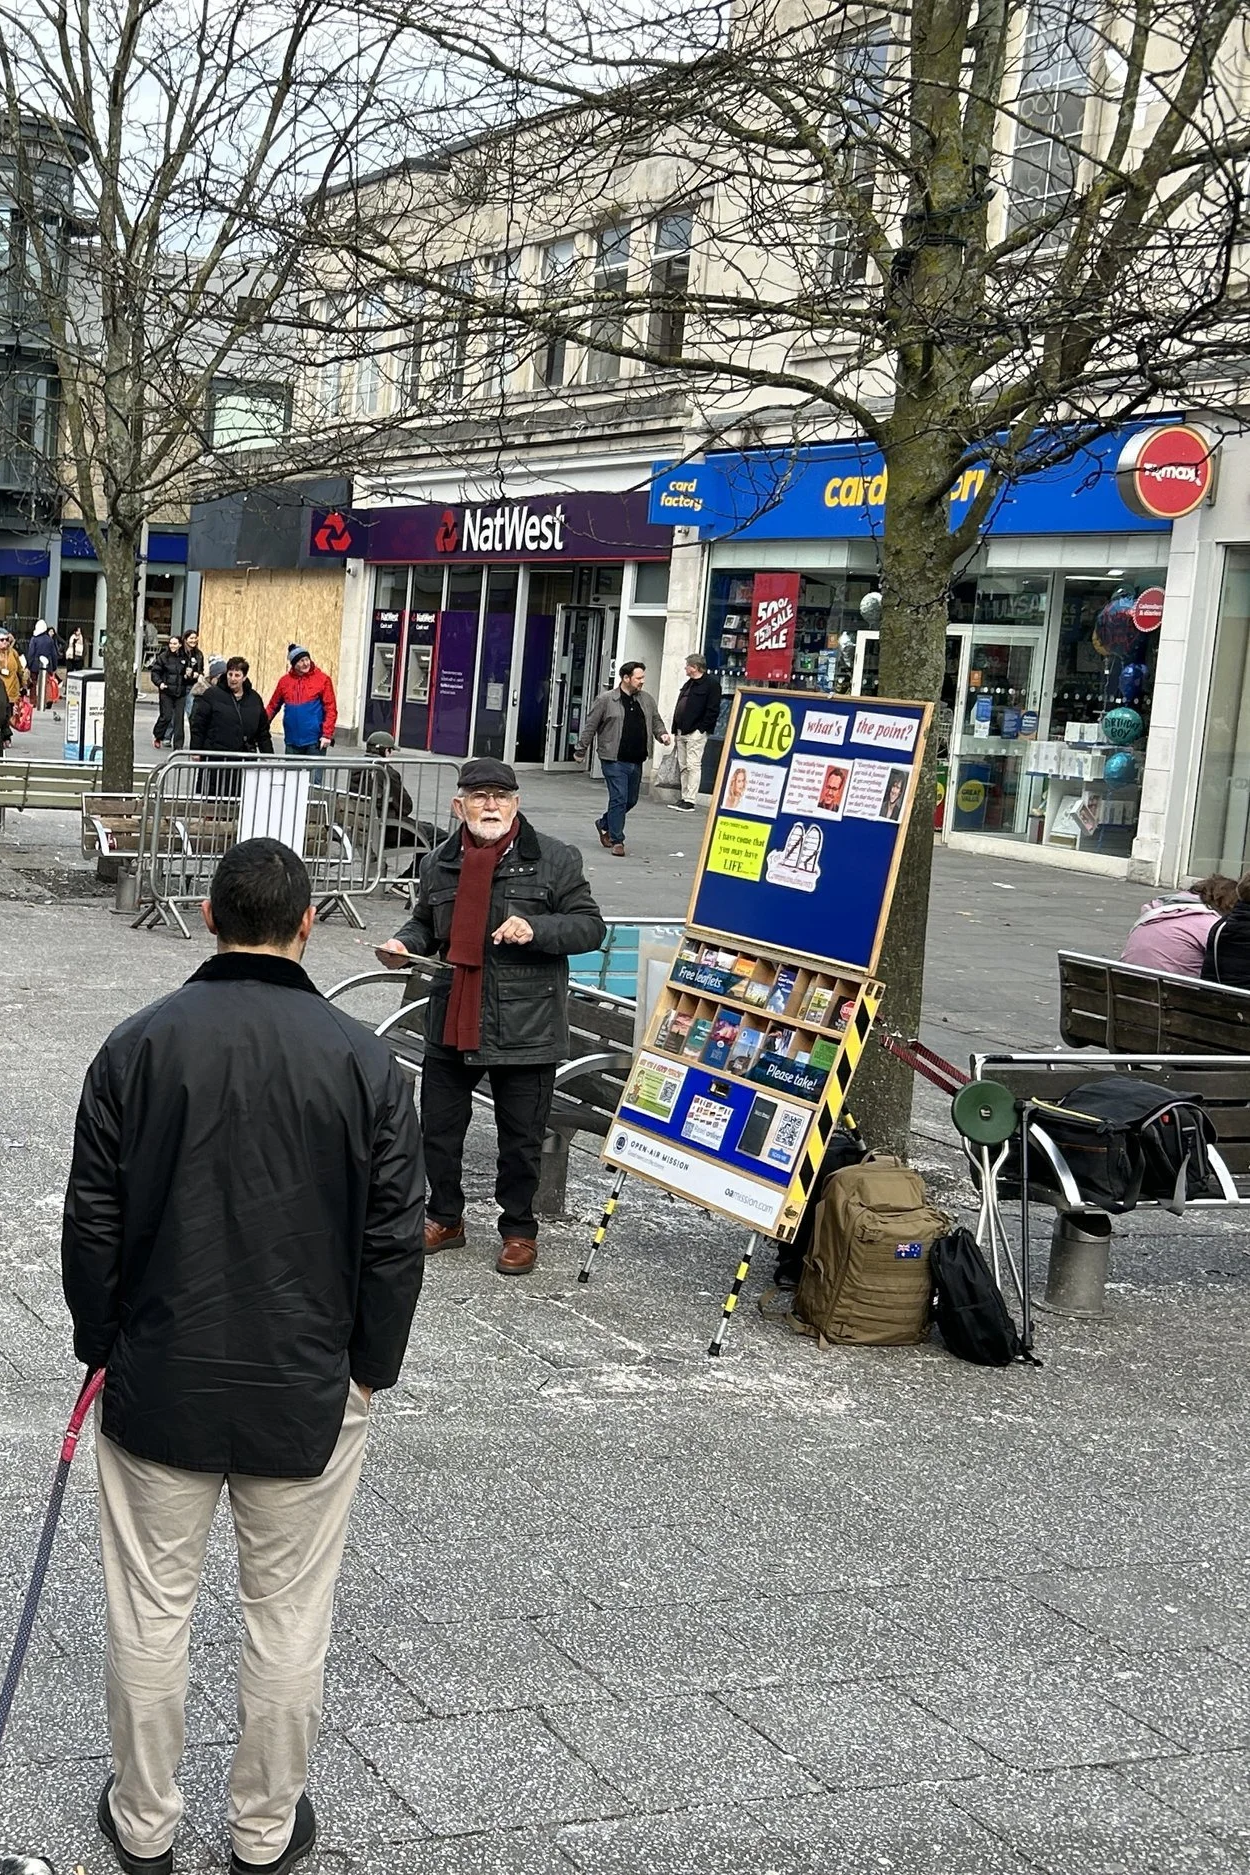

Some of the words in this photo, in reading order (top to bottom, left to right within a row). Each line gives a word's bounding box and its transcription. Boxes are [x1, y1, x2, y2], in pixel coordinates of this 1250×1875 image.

[669, 478, 698, 493] card
[824, 463, 888, 508] card
[660, 492, 703, 511] factory
[462, 504, 565, 552] NatWest
[771, 604, 794, 632] SALE
[736, 706, 792, 752] Life
[806, 718, 843, 737] what's
[856, 719, 873, 735] the
[873, 724, 914, 741] point?
[1111, 728, 1131, 738] BOY
[722, 832, 735, 842] have
[736, 835, 752, 845] come
[752, 837, 765, 847] that
[718, 845, 730, 855] you
[731, 847, 743, 858] may
[744, 849, 758, 860] have
[679, 966, 695, 981] Free
[695, 970, 723, 988] leaflets
[766, 1063, 794, 1083] Please
[794, 1075, 817, 1091] take!
[630, 1140, 661, 1158] OPEN-AIR
[661, 1154, 689, 1171] MISSION
[724, 1188, 774, 1215] oamission.com
